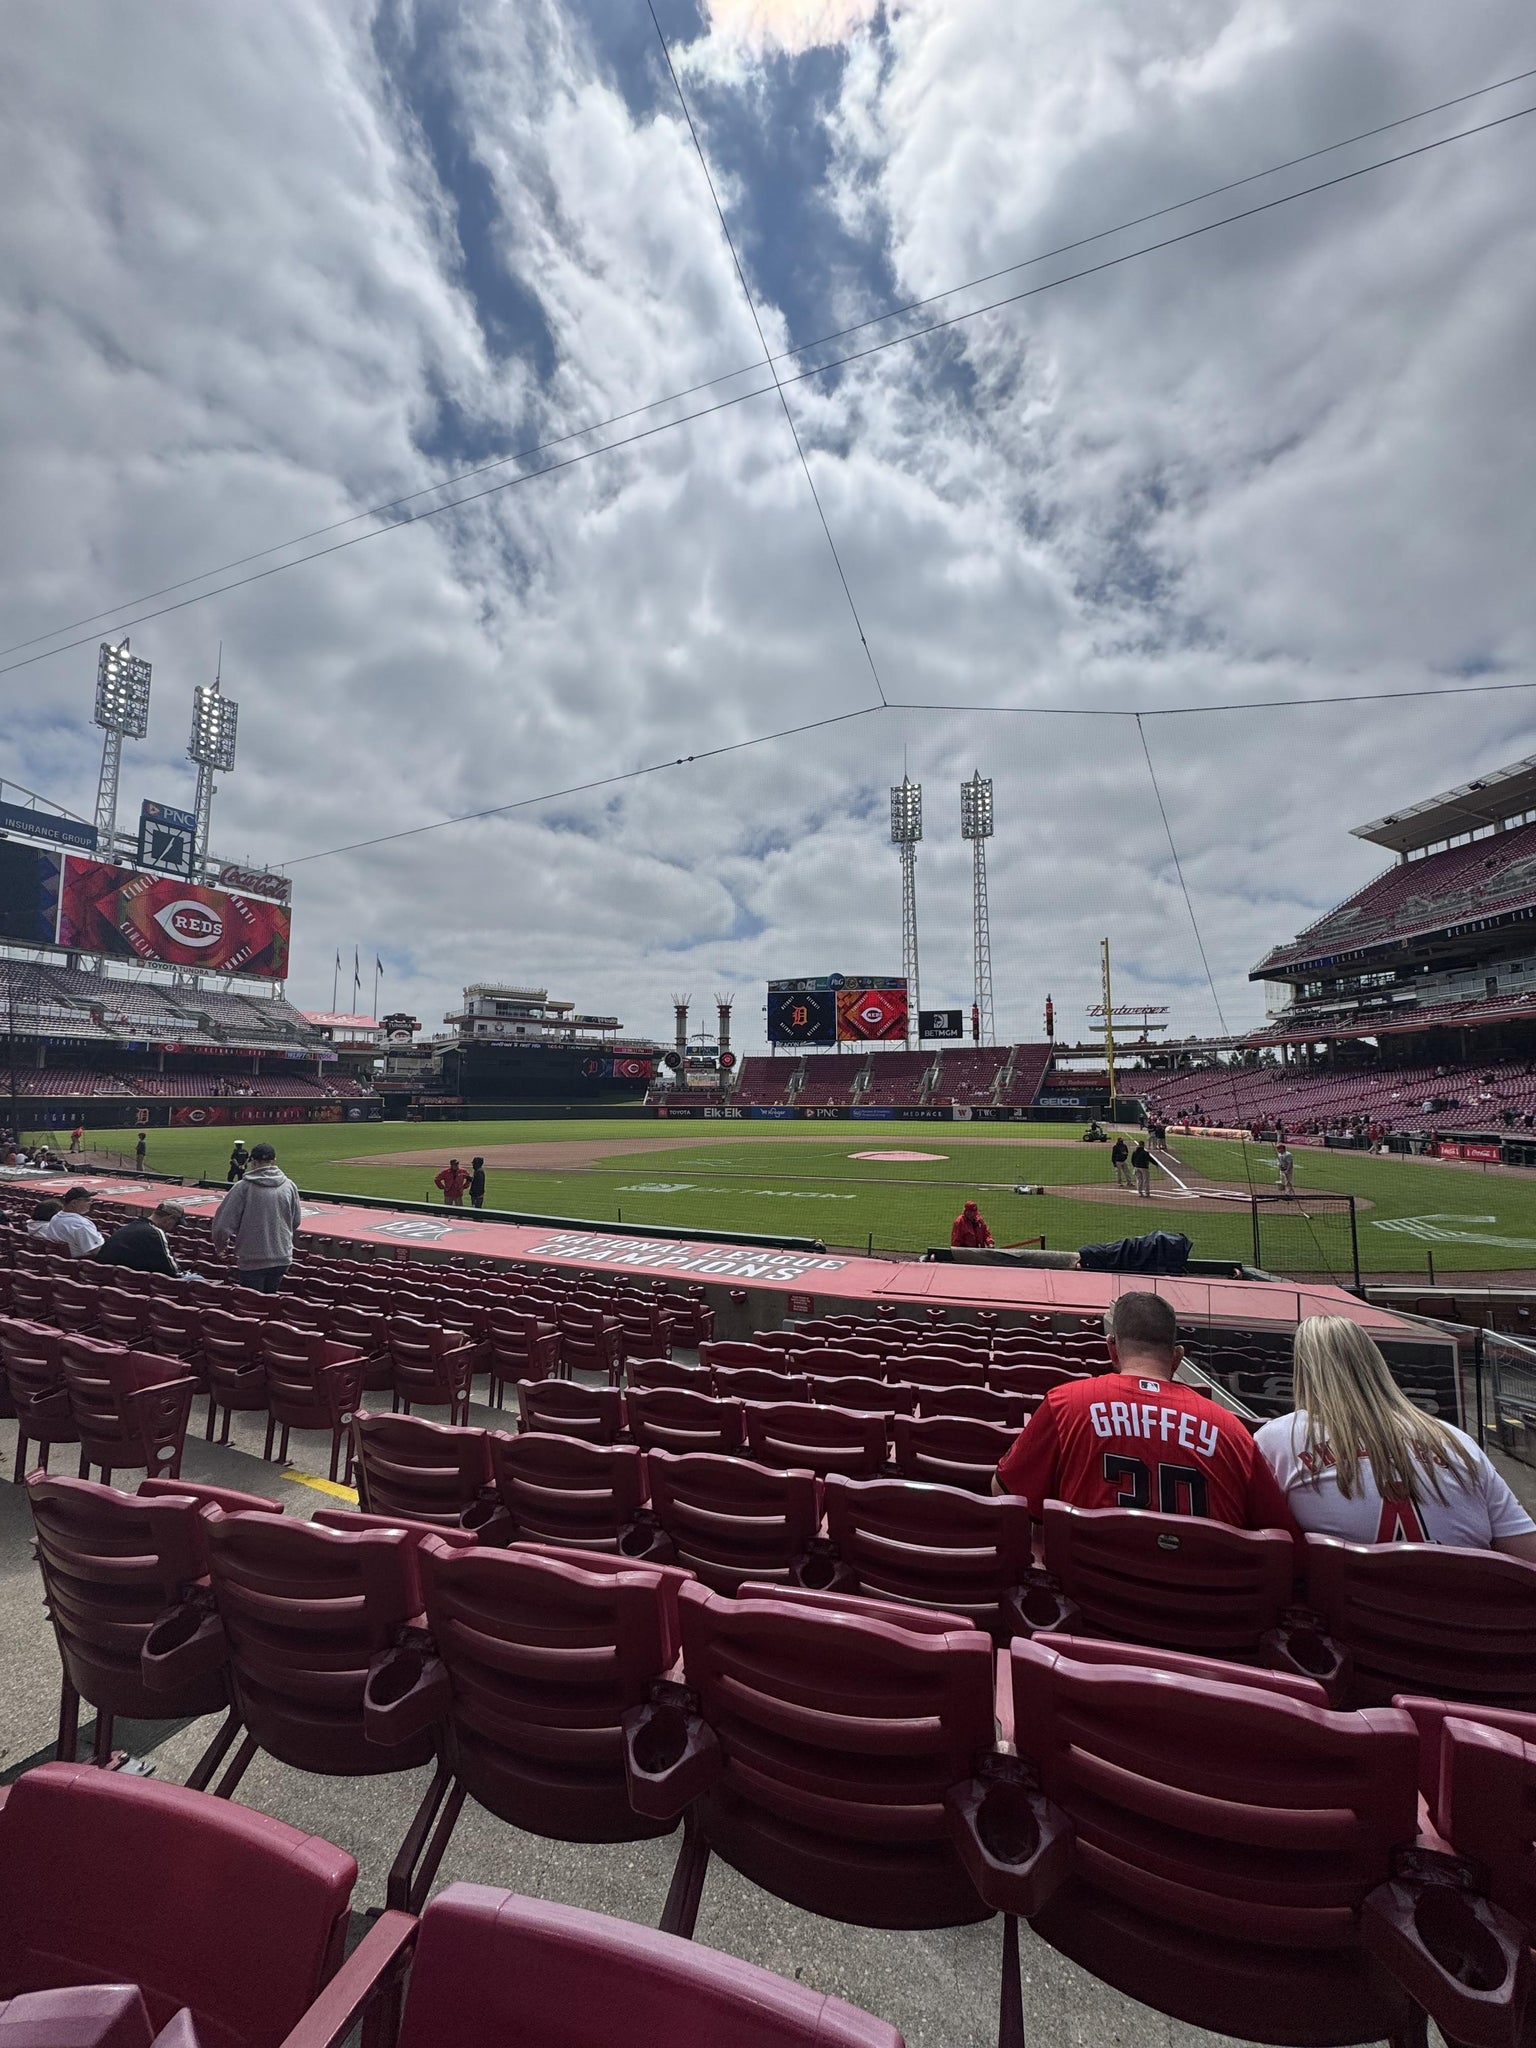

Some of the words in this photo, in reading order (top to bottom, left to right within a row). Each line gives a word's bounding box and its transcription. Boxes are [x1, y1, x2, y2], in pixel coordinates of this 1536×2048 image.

[163, 806, 197, 828] PNC
[5, 818, 60, 838] INSURANCE
[62, 833, 92, 846] GROUP
[175, 915, 223, 936] REDS
[148, 961, 178, 972] TOYOTA
[179, 966, 209, 976] TUNDRA
[924, 1029, 958, 1037] BETMGM
[1039, 1097, 1080, 1106] GEICO
[816, 1108, 839, 1118] PNC
[977, 1109, 997, 1117] TWC
[527, 1244, 805, 1281] CHAMPIONS
[546, 1234, 695, 1255] NATIONAL
[698, 1248, 850, 1270] LEAGUE
[1089, 1401, 1219, 1457] GRIFFEY
